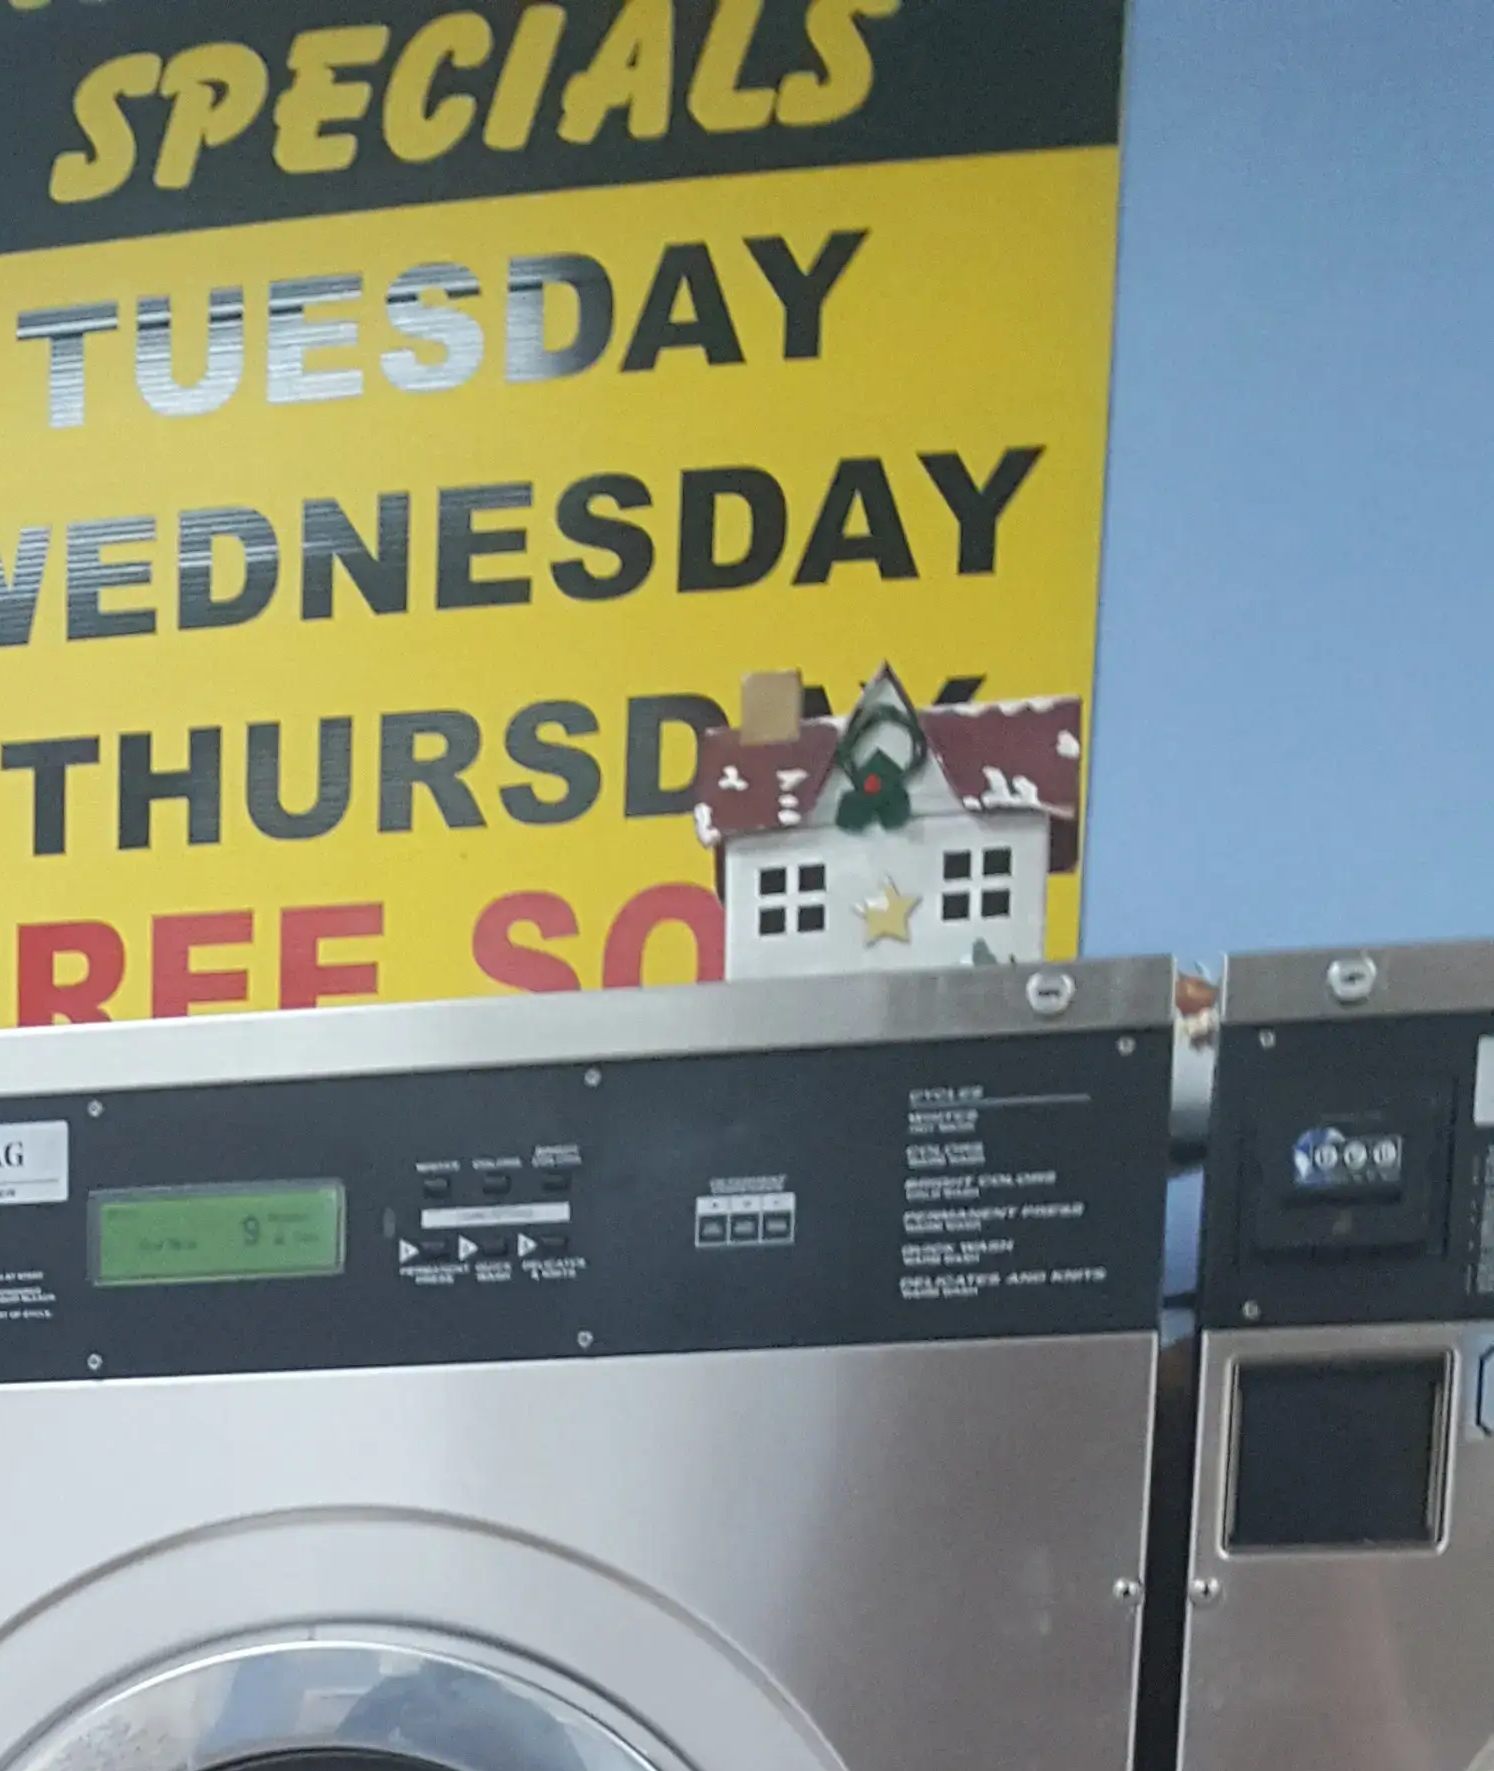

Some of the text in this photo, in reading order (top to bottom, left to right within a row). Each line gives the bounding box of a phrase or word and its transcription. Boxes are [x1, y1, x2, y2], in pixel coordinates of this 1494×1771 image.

[49, 0, 902, 203] SPECIALS
[16, 229, 871, 430] TUESDAY
[0, 674, 986, 856] THURSD
[471, 881, 724, 993] SO
